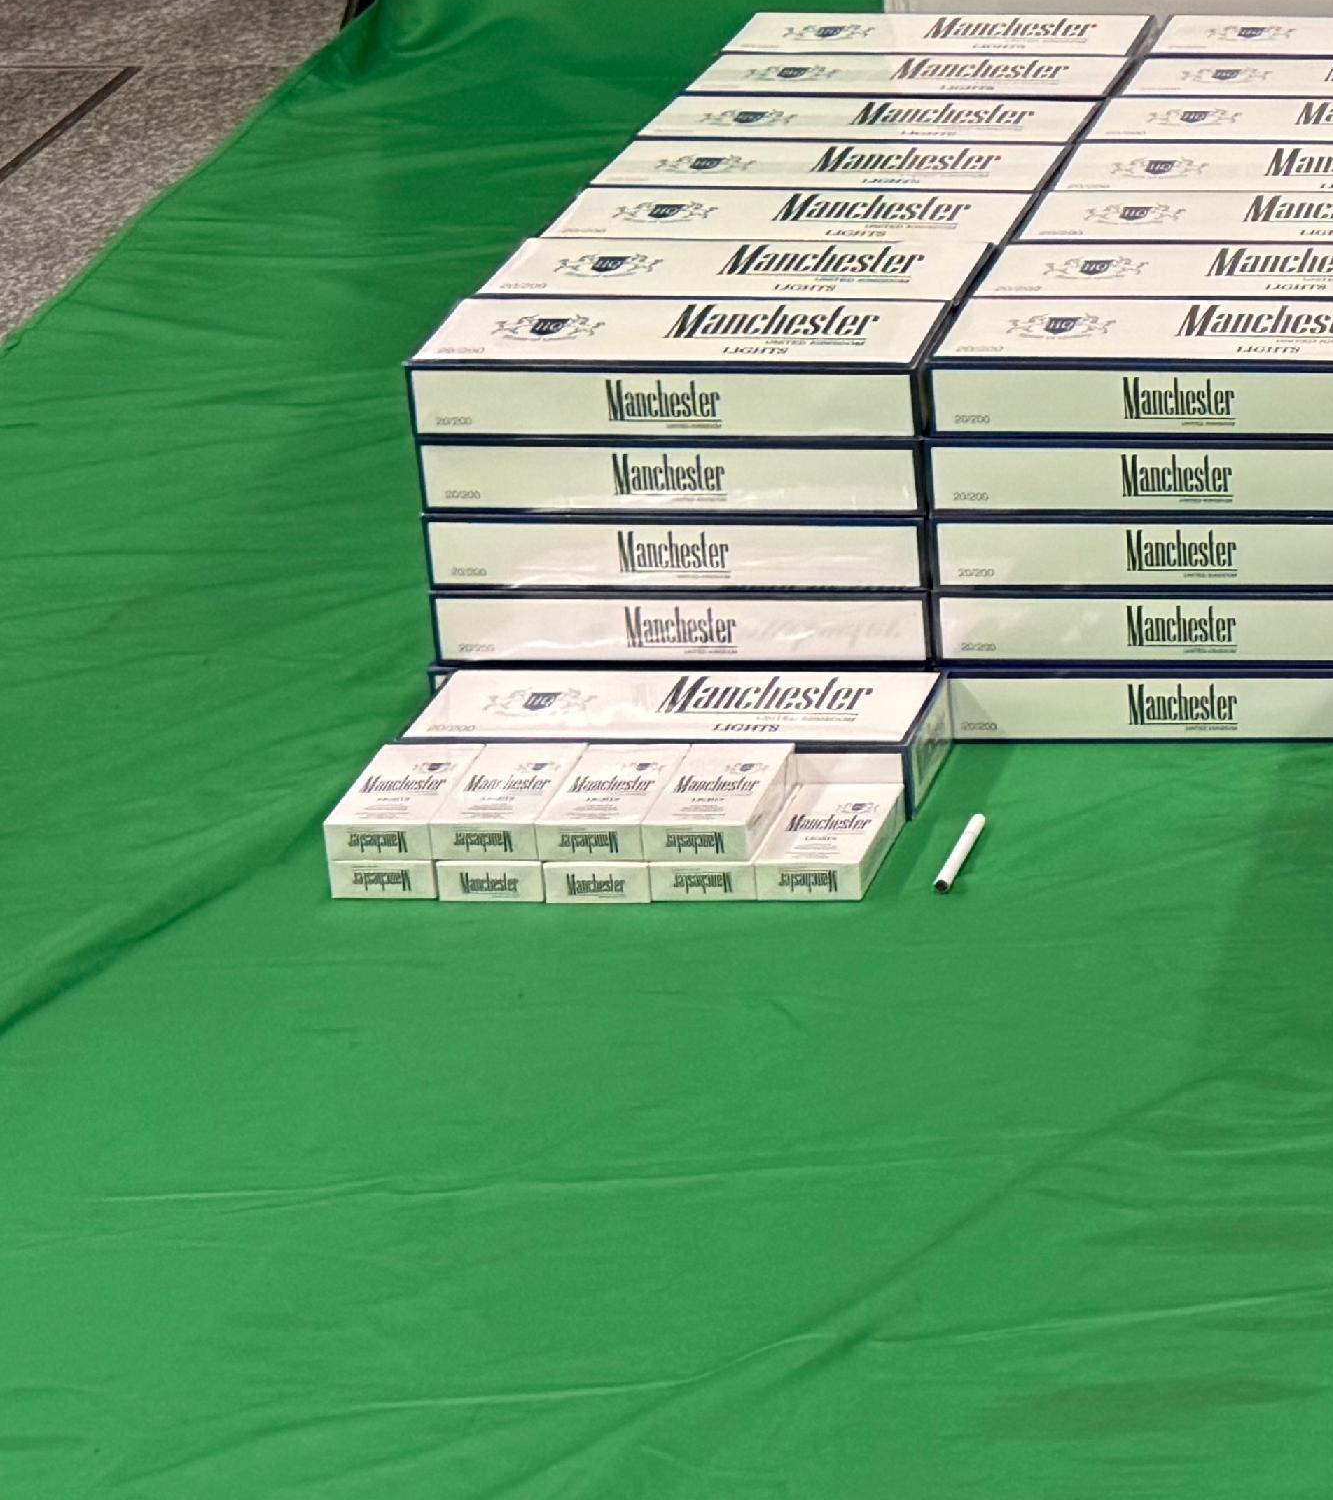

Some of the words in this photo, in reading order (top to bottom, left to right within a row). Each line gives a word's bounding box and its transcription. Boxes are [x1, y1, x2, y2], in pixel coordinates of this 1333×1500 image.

[923, 16, 1097, 39] Manchester
[890, 57, 1069, 81] Manchester
[849, 101, 1035, 125] Manchester
[809, 145, 1002, 172] Manchester
[771, 193, 972, 222] Manchester
[716, 244, 925, 276] Manchester
[663, 303, 880, 339] Manchester
[722, 346, 789, 355] LIGHTS
[605, 379, 721, 422] Manchester
[1122, 376, 1235, 419] Manchester
[612, 453, 726, 495] Manchester
[1120, 454, 1233, 497] Manchester
[617, 530, 730, 573] Manchester
[1126, 529, 1237, 571] Manchester
[624, 605, 737, 648] Manchester
[1126, 605, 1237, 646] Manchester
[655, 675, 874, 714] Manchester
[1127, 683, 1238, 726] Manchester
[712, 723, 781, 732] LIGHTS
[359, 775, 447, 793] Manchester
[463, 774, 552, 792] Manchester
[568, 775, 655, 793] Manchester
[673, 775, 760, 793] Manchester
[785, 813, 872, 832] Manchester
[460, 872, 519, 894] Manchester
[567, 872, 626, 895] Manchester
